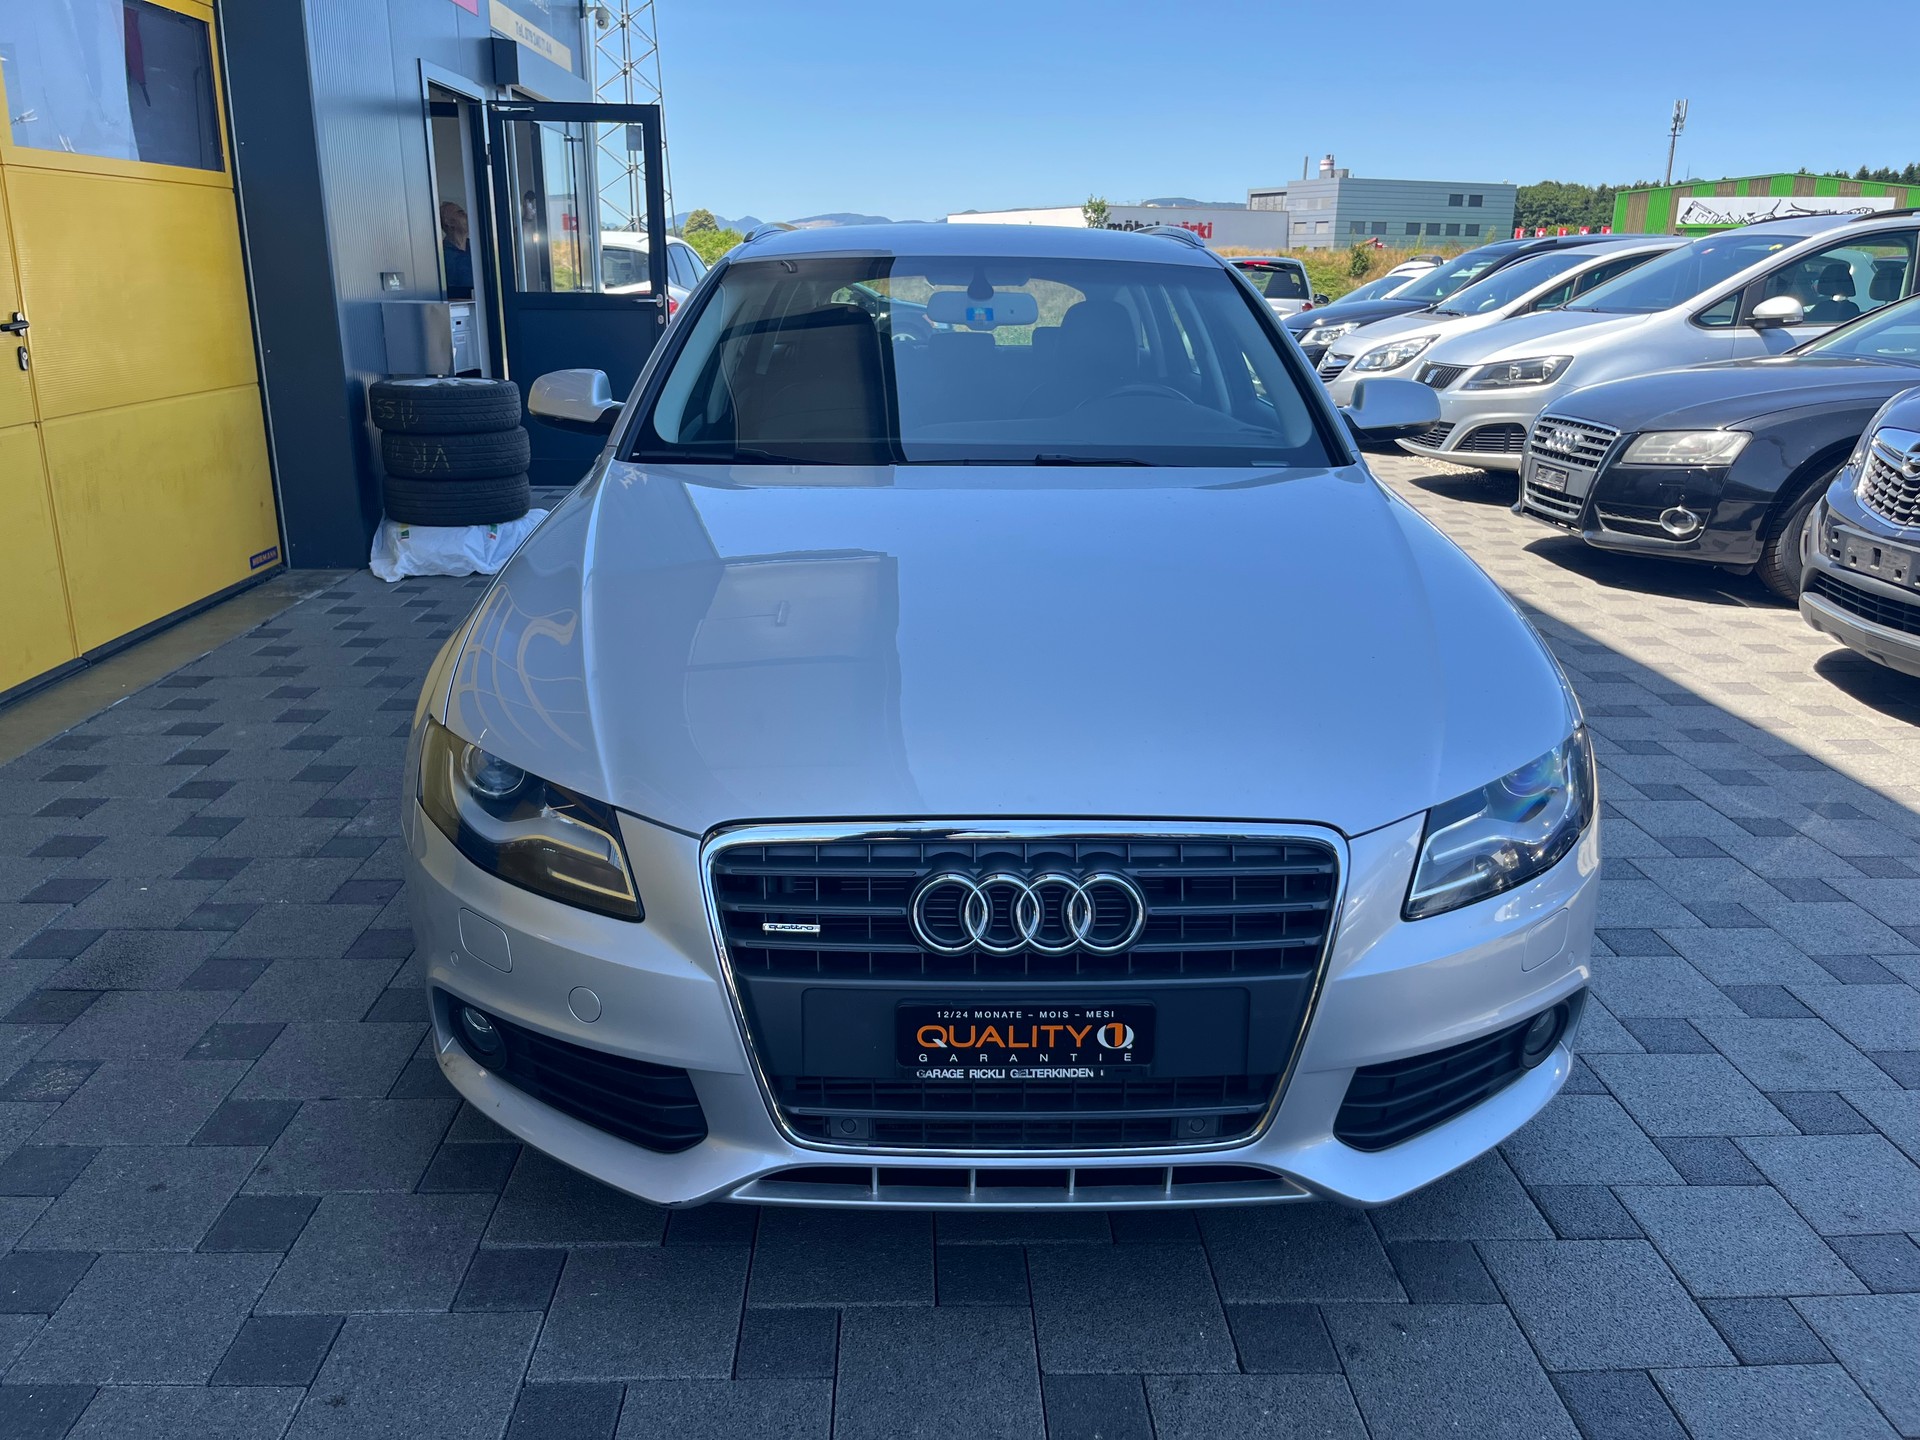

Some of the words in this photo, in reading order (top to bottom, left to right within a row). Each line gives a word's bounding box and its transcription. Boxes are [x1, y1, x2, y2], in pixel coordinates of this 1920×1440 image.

[1086, 1010, 1115, 1018] MESI
[916, 1024, 1093, 1048] QUALITY
[918, 1053, 1132, 1062] GARANTIE
[916, 1069, 964, 1079] GARAGE
[969, 1069, 1006, 1079] RICKLI
[1010, 1068, 1094, 1079] GELTERKINDEN
